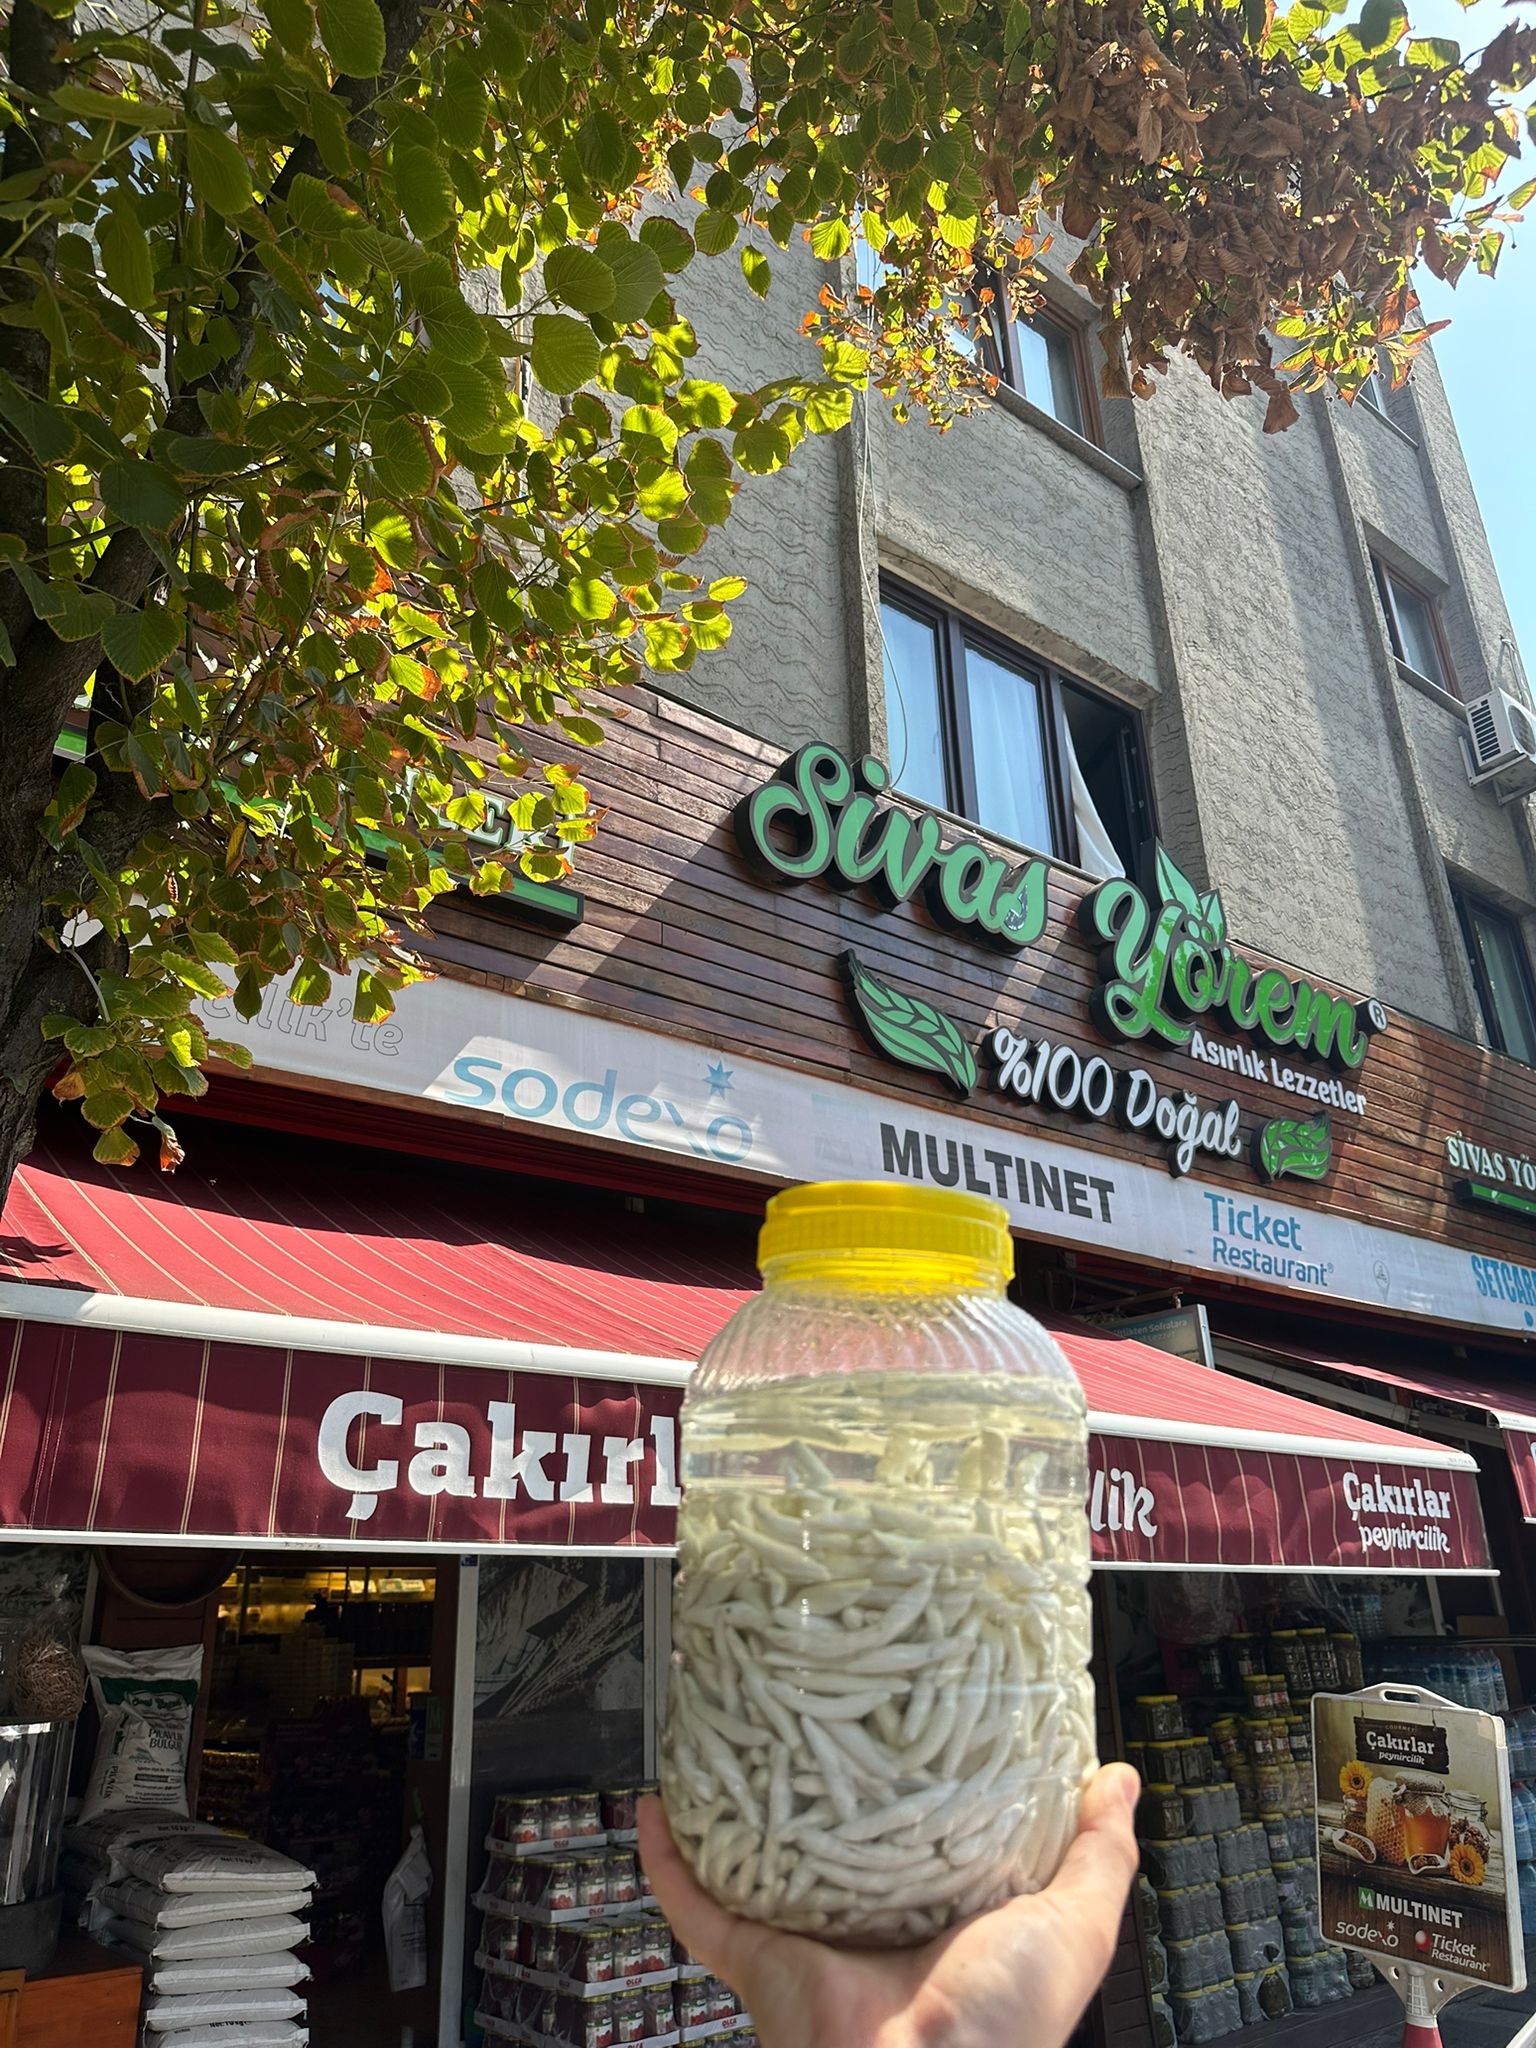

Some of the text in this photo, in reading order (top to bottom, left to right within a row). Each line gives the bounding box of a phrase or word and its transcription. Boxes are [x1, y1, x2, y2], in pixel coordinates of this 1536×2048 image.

[749, 741, 1048, 947] Sivas
[1093, 876, 1368, 1071] Yörem
[1191, 1031, 1368, 1116] Asırlık Lezzetler
[993, 1026, 1241, 1175] %100 Doğal
[880, 1122, 1115, 1224] MULTINET
[1507, 1153, 1536, 1191] YÖ
[1204, 1191, 1303, 1252] Ticket
[1343, 1472, 1451, 1522] Çakırlar
[1359, 1522, 1451, 1554] peynircilik
[1366, 1731, 1436, 1755] Çakırlar
[1378, 1750, 1425, 1766] peynircilik
[1376, 1893, 1463, 1929] MULTINET
[1336, 1921, 1399, 1948] sodexo
[1432, 1933, 1477, 1958] Ticket
